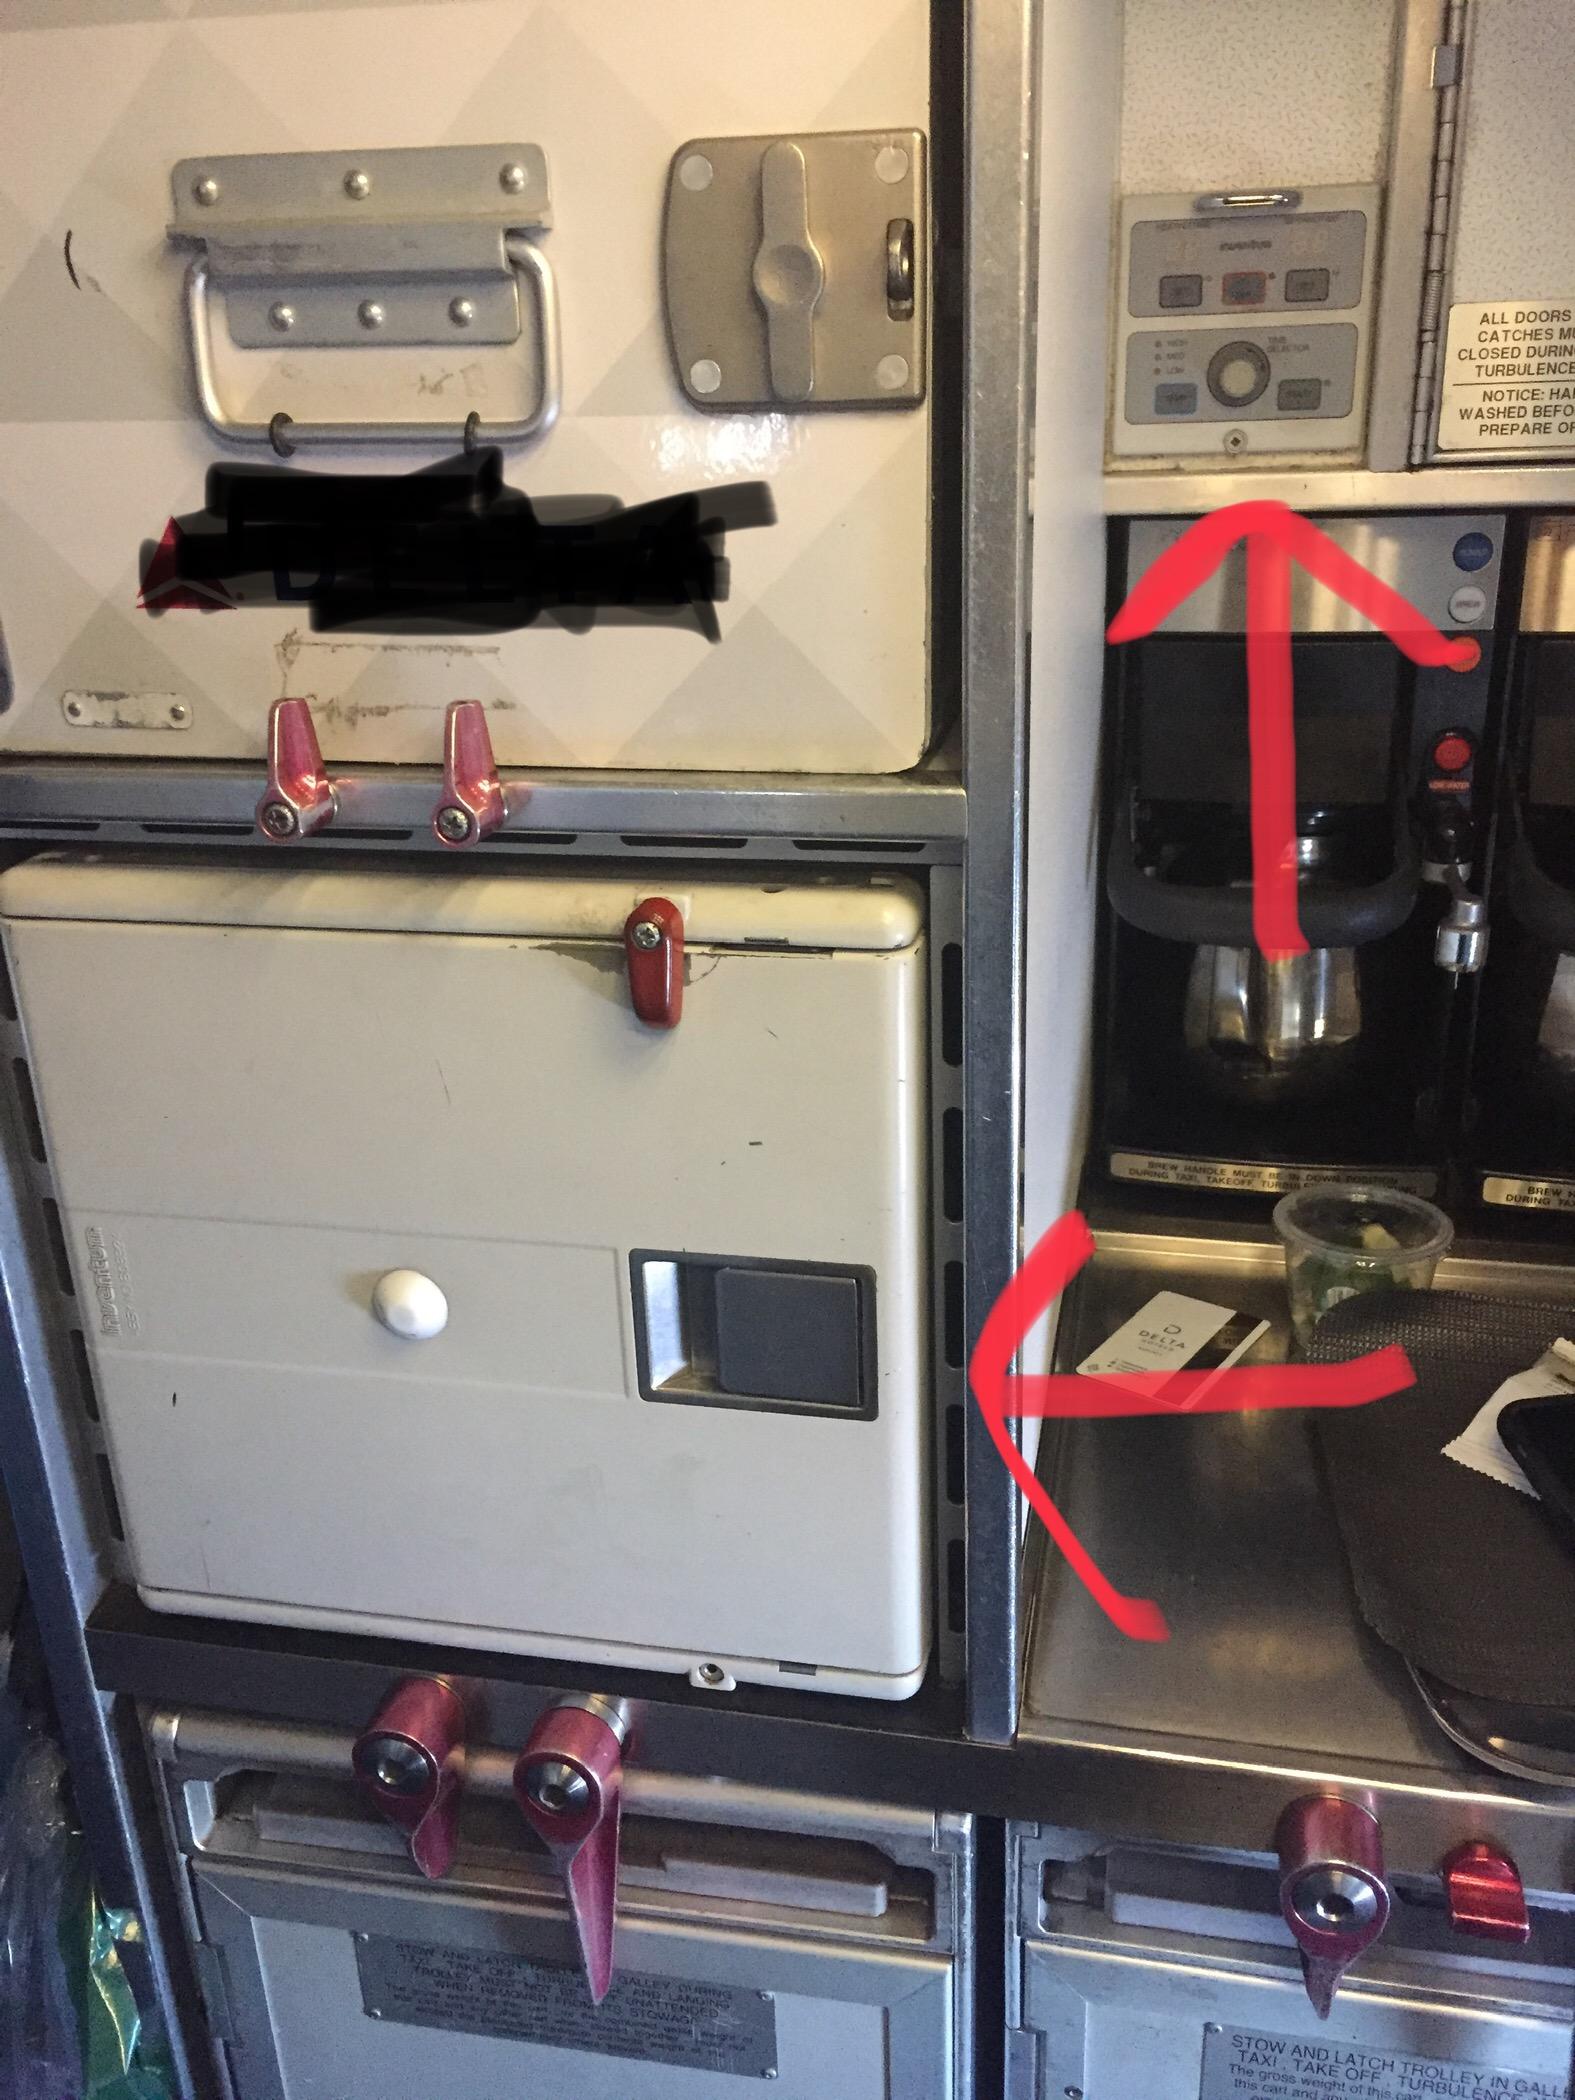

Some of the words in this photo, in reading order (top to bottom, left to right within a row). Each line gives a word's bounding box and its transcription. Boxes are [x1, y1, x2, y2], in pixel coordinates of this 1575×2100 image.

[1479, 312, 1509, 325] ALL
[1514, 309, 1572, 324] DOORS
[1477, 328, 1554, 343] CATCHES
[1457, 346, 1521, 361] CLOSED
[1525, 345, 1575, 358] DURIN
[1475, 361, 1575, 377] TURBULENCE
[1482, 388, 1545, 402] NOTICE:
[1459, 405, 1527, 420] WASHED
[1479, 422, 1553, 436] PREPARE
[1128, 1167, 1169, 1180] DURING
[1147, 1160, 1179, 1171] BREW
[1183, 1165, 1227, 1176] HANDLE
[1232, 1169, 1263, 1179] MUST
[1268, 1171, 1282, 1181] BE
[1305, 1174, 1342, 1184] DOWN
[1505, 1193, 1551, 1206] DURING
[1527, 1186, 1562, 1197] BREW
[1138, 1329, 1185, 1349] DELTA
[1230, 2033, 1287, 2055] STOW
[1290, 2044, 1329, 2061] AND
[1334, 2050, 1395, 2073] LATCH
[1400, 2060, 1484, 2086] TROLLEY
[1489, 2075, 1510, 2090] IN
[1292, 2058, 1341, 2078] TAKE
[1344, 2066, 1382, 2084] OFF
[1228, 2064, 1255, 2078] The
[1258, 2070, 1297, 2086] gross
[1300, 2077, 1346, 2092] weight
[1349, 2084, 1363, 2095] of
[1366, 2086, 1392, 2099] this
[1233, 2078, 1259, 2091] this
[1262, 2083, 1288, 2095] cart
[1291, 2089, 1319, 2100] and
